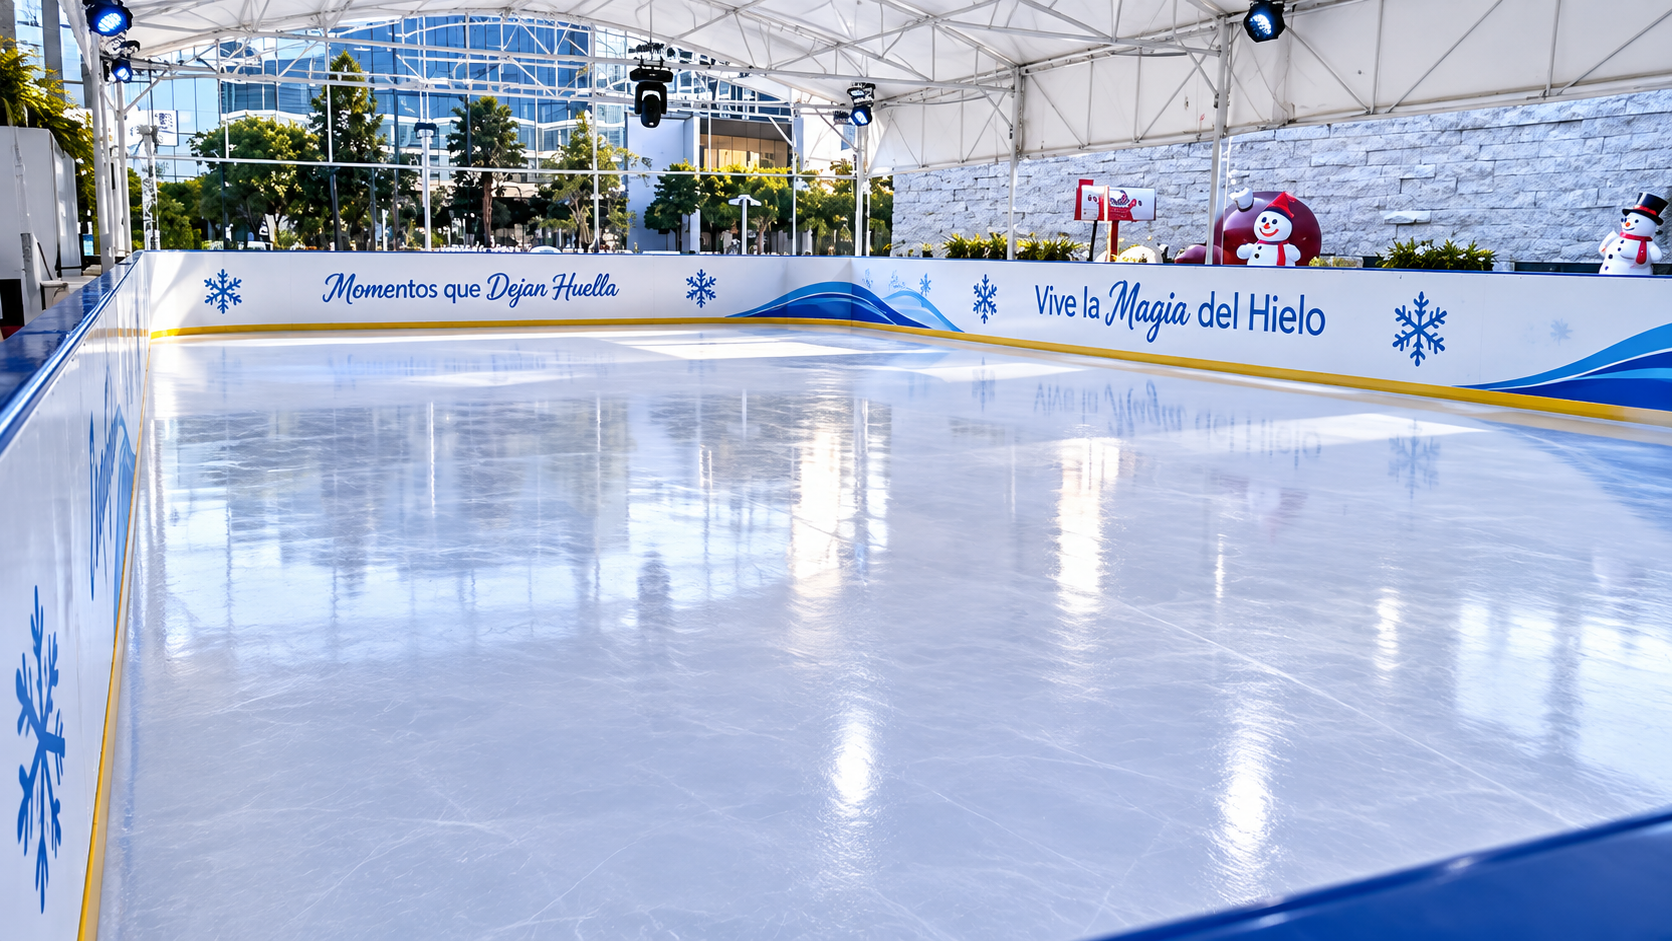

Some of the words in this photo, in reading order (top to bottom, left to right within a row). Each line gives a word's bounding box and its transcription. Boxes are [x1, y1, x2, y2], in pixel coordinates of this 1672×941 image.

[321, 272, 439, 305] Momentos
[443, 283, 482, 305] que
[486, 272, 549, 309] Dejan
[551, 271, 620, 302] Huella
[1034, 284, 1077, 318] Vive
[1082, 285, 1100, 320] la
[1104, 279, 1192, 344] Magia
[1197, 290, 1240, 330] del
[1248, 292, 1327, 337] Hielo
